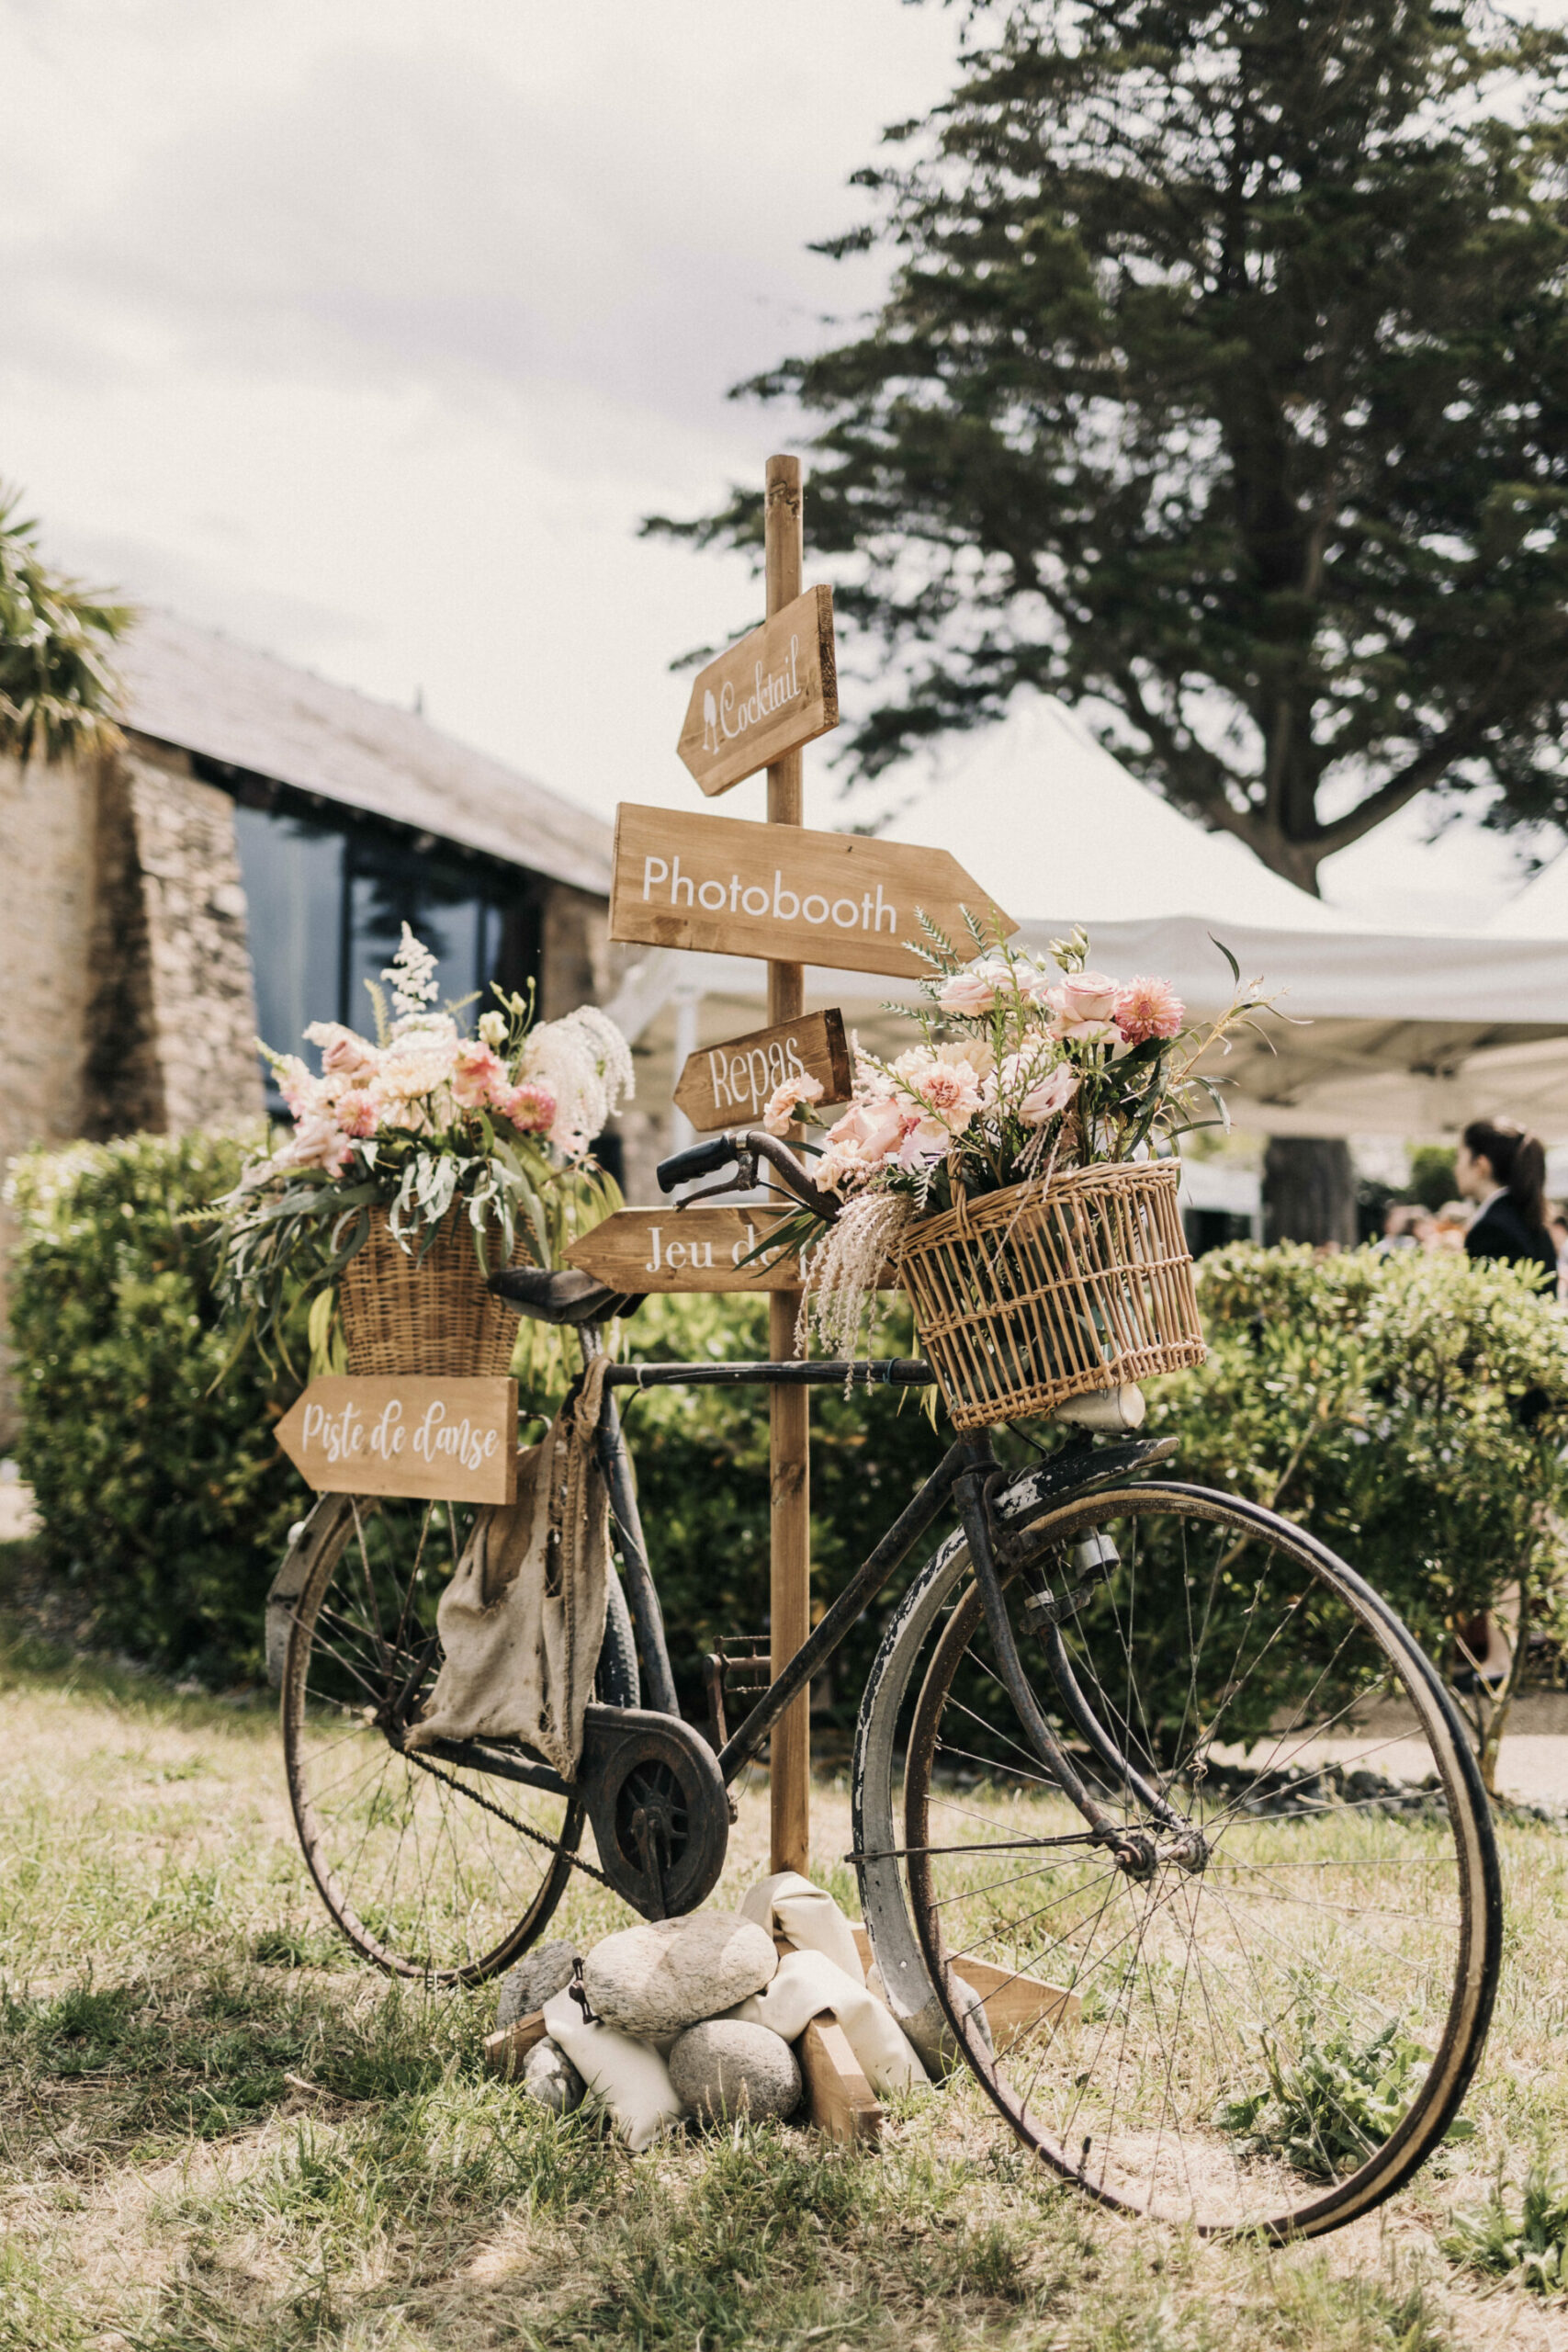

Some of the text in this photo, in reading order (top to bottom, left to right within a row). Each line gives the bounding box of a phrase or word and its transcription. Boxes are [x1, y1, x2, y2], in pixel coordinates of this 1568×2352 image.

[719, 634, 802, 740] Cocktail
[642, 855, 897, 934] Photobooth
[708, 1036, 805, 1115] Repas
[645, 1227, 715, 1273] Jeu
[301, 1398, 501, 1471] Piste de danse
